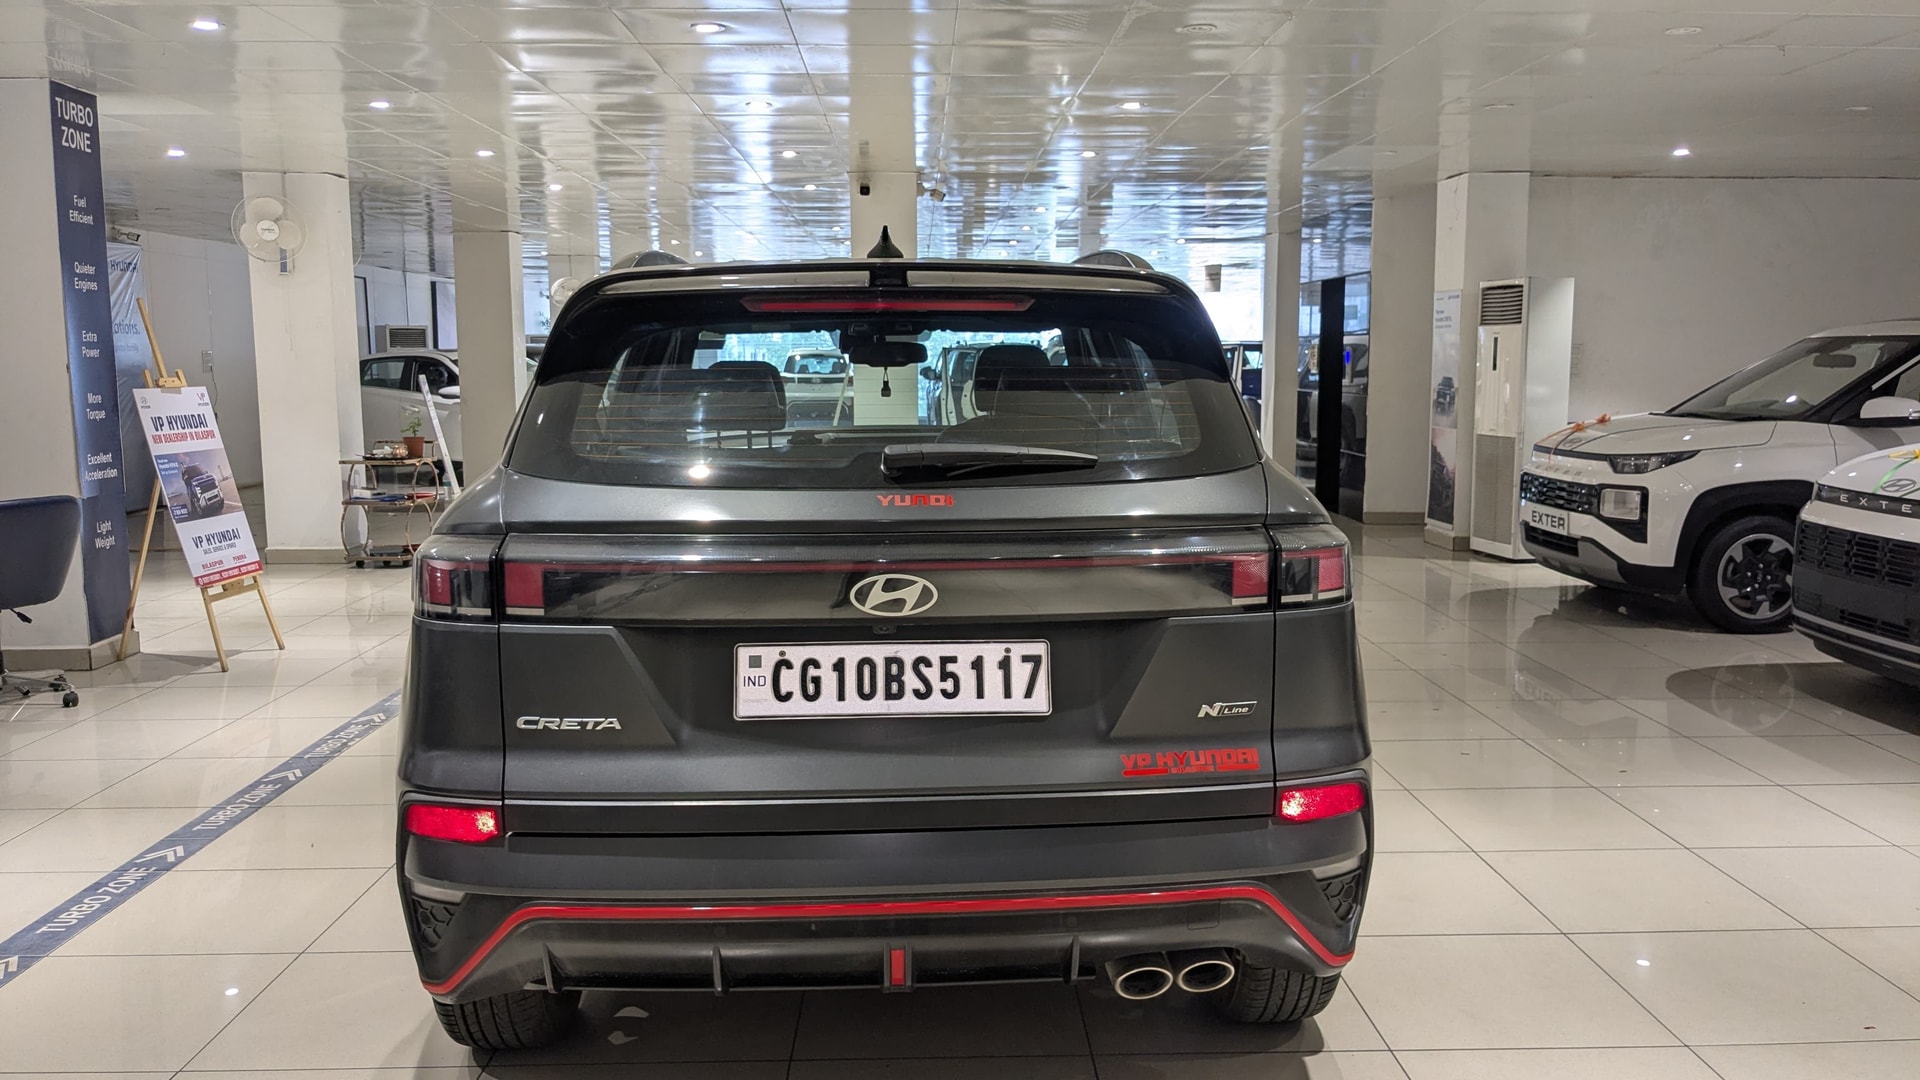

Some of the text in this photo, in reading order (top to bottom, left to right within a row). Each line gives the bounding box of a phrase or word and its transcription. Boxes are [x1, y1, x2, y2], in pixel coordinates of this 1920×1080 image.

[55, 97, 94, 127] TURBO
[61, 126, 92, 153] ZONE
[73, 195, 87, 208] Fuel
[69, 210, 94, 225] Efficient
[74, 262, 96, 274] Quieter
[74, 278, 98, 292] Engines
[82, 331, 98, 342] Extra
[82, 347, 101, 358] Power
[88, 393, 102, 404] More
[86, 409, 106, 423] Torque
[150, 413, 209, 432] VP HYUNDAI
[152, 434, 164, 445] NEW
[87, 452, 113, 465] Excellent
[85, 467, 118, 481] Acceleration
[96, 520, 112, 534] Light
[1531, 510, 1565, 531] EXTER
[95, 535, 116, 549] Weight
[192, 528, 241, 549] VP HYUNDAI
[743, 675, 767, 687] IND
[771, 654, 1042, 702] CG10BS5117
[1223, 705, 1249, 714] Line
[516, 716, 622, 730] CRETA
[336, 722, 370, 741] ZONE
[1120, 748, 1259, 768] VP HYUNDAI
[192, 783, 282, 831] TURBO ZONE
[35, 866, 157, 934] TURBO ZONE
